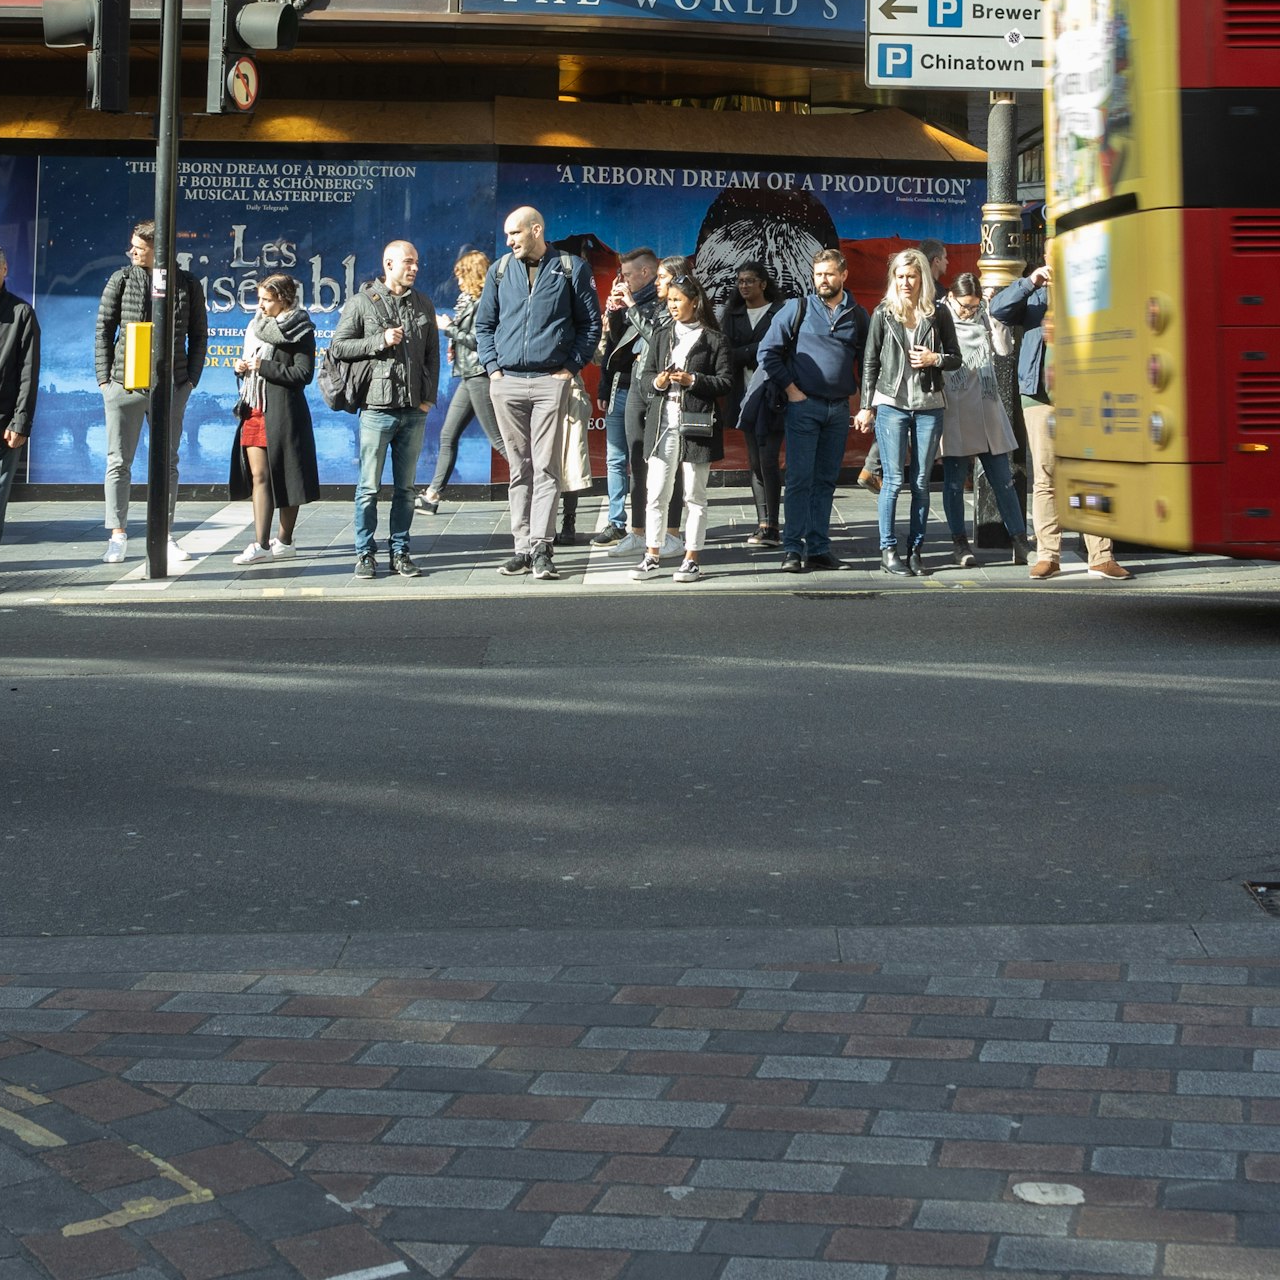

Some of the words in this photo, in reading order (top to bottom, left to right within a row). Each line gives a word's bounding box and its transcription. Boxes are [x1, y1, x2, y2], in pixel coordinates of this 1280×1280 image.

[972, 3, 1041, 21] Brewer
[920, 54, 1025, 71] Chinatown
[177, 163, 223, 174] EBORN
[227, 164, 278, 175] DREAM
[282, 165, 301, 176] OF
[304, 166, 313, 176] A
[318, 166, 416, 178] PRODUCTION
[177, 176, 187, 187] F
[190, 176, 255, 188] BOUBLIL
[257, 177, 270, 188] &
[582, 166, 675, 186] REBORN
[682, 168, 760, 189] DREAM
[767, 171, 795, 191] OF
[801, 173, 815, 191] A
[185, 189, 250, 201] MUSICAL
[246, 204, 262, 212] Daily
[262, 205, 289, 213] Telegraph
[230, 224, 297, 269] Les
[217, 327, 248, 337] THEAT
